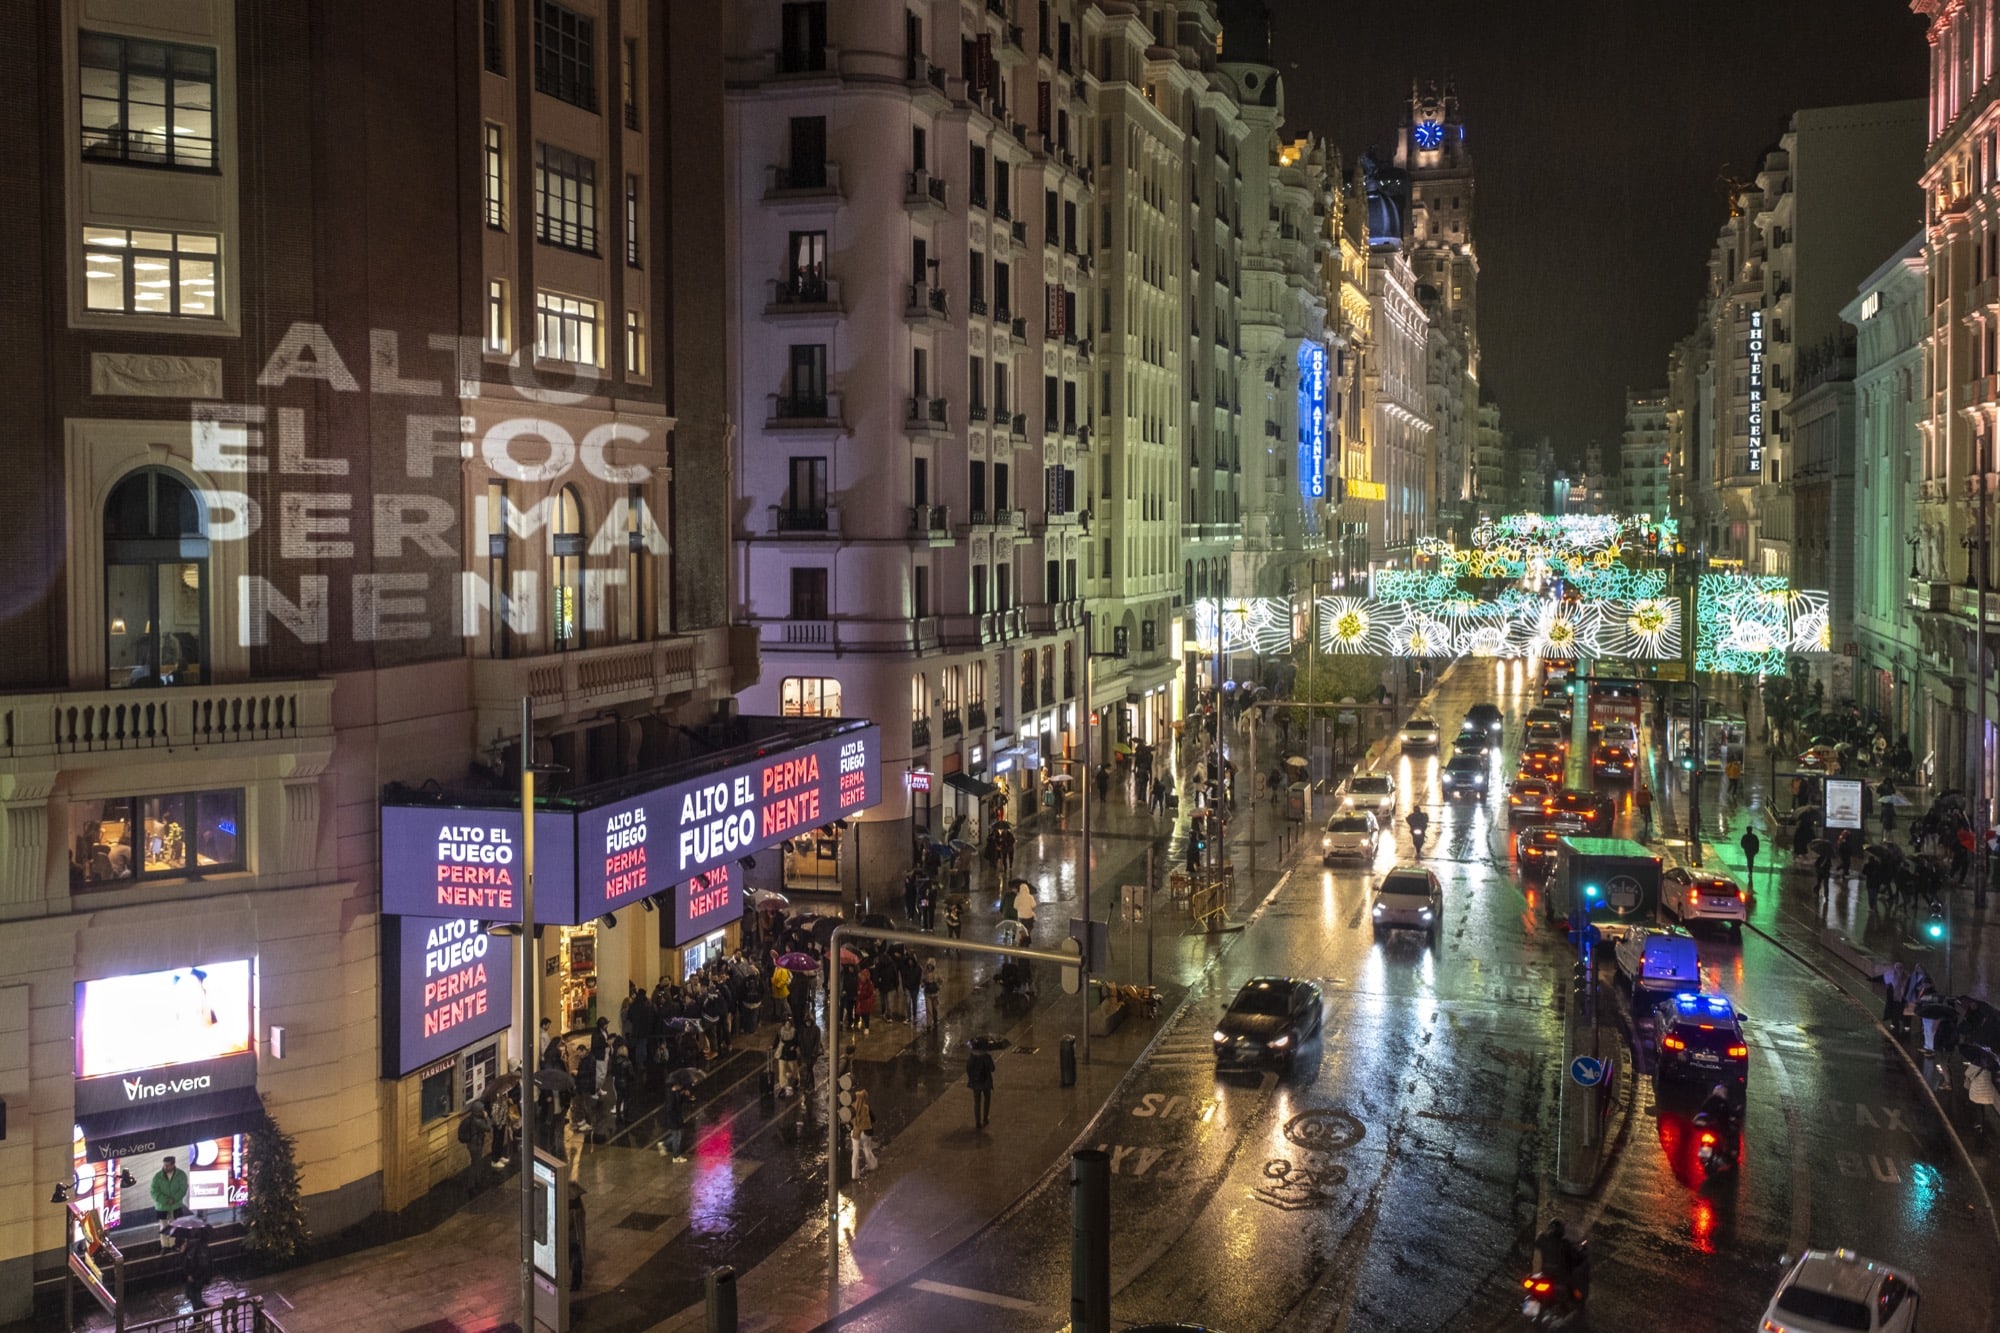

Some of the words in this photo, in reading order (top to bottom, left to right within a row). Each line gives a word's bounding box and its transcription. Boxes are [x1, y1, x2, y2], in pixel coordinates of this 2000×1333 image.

[257, 322, 598, 404] ALTO
[1313, 351, 1322, 400] HOTEL
[1750, 329, 1762, 386] HOTEL
[190, 403, 350, 475] EL
[405, 413, 655, 483] FOC
[1750, 391, 1761, 470] REGENTE
[1312, 406, 1322, 495] ATLANTICO
[180, 488, 673, 559] PERMA
[237, 568, 632, 647] NENT
[840, 753, 864, 774] FUEGO
[841, 743, 855, 758] ALTO
[857, 740, 864, 752] EL
[762, 754, 819, 798] PERMA
[840, 771, 864, 791] PERMA
[680, 782, 728, 825] ALTO
[734, 775, 754, 806] EL
[762, 788, 820, 838] NENTE
[840, 786, 865, 808] NENTE
[439, 826, 484, 843] ALTO
[490, 828, 511, 843] EL
[606, 824, 646, 854] FUEGO
[607, 814, 632, 833] ALTO
[634, 808, 646, 823] EL
[680, 809, 755, 870] FUEGO
[438, 843, 513, 864] FUEGO
[606, 846, 646, 876] PERMA
[437, 865, 512, 886] PERMA
[606, 867, 647, 899] NENTE
[437, 886, 512, 908] NENTE
[690, 886, 729, 920] NENTE
[426, 919, 466, 949] ALTO
[470, 918, 479, 934] E
[426, 934, 488, 978] FUEGO
[424, 963, 487, 1007] PERMA
[424, 989, 487, 1039] NENTE
[422, 1058, 456, 1080] TAQUILLA
